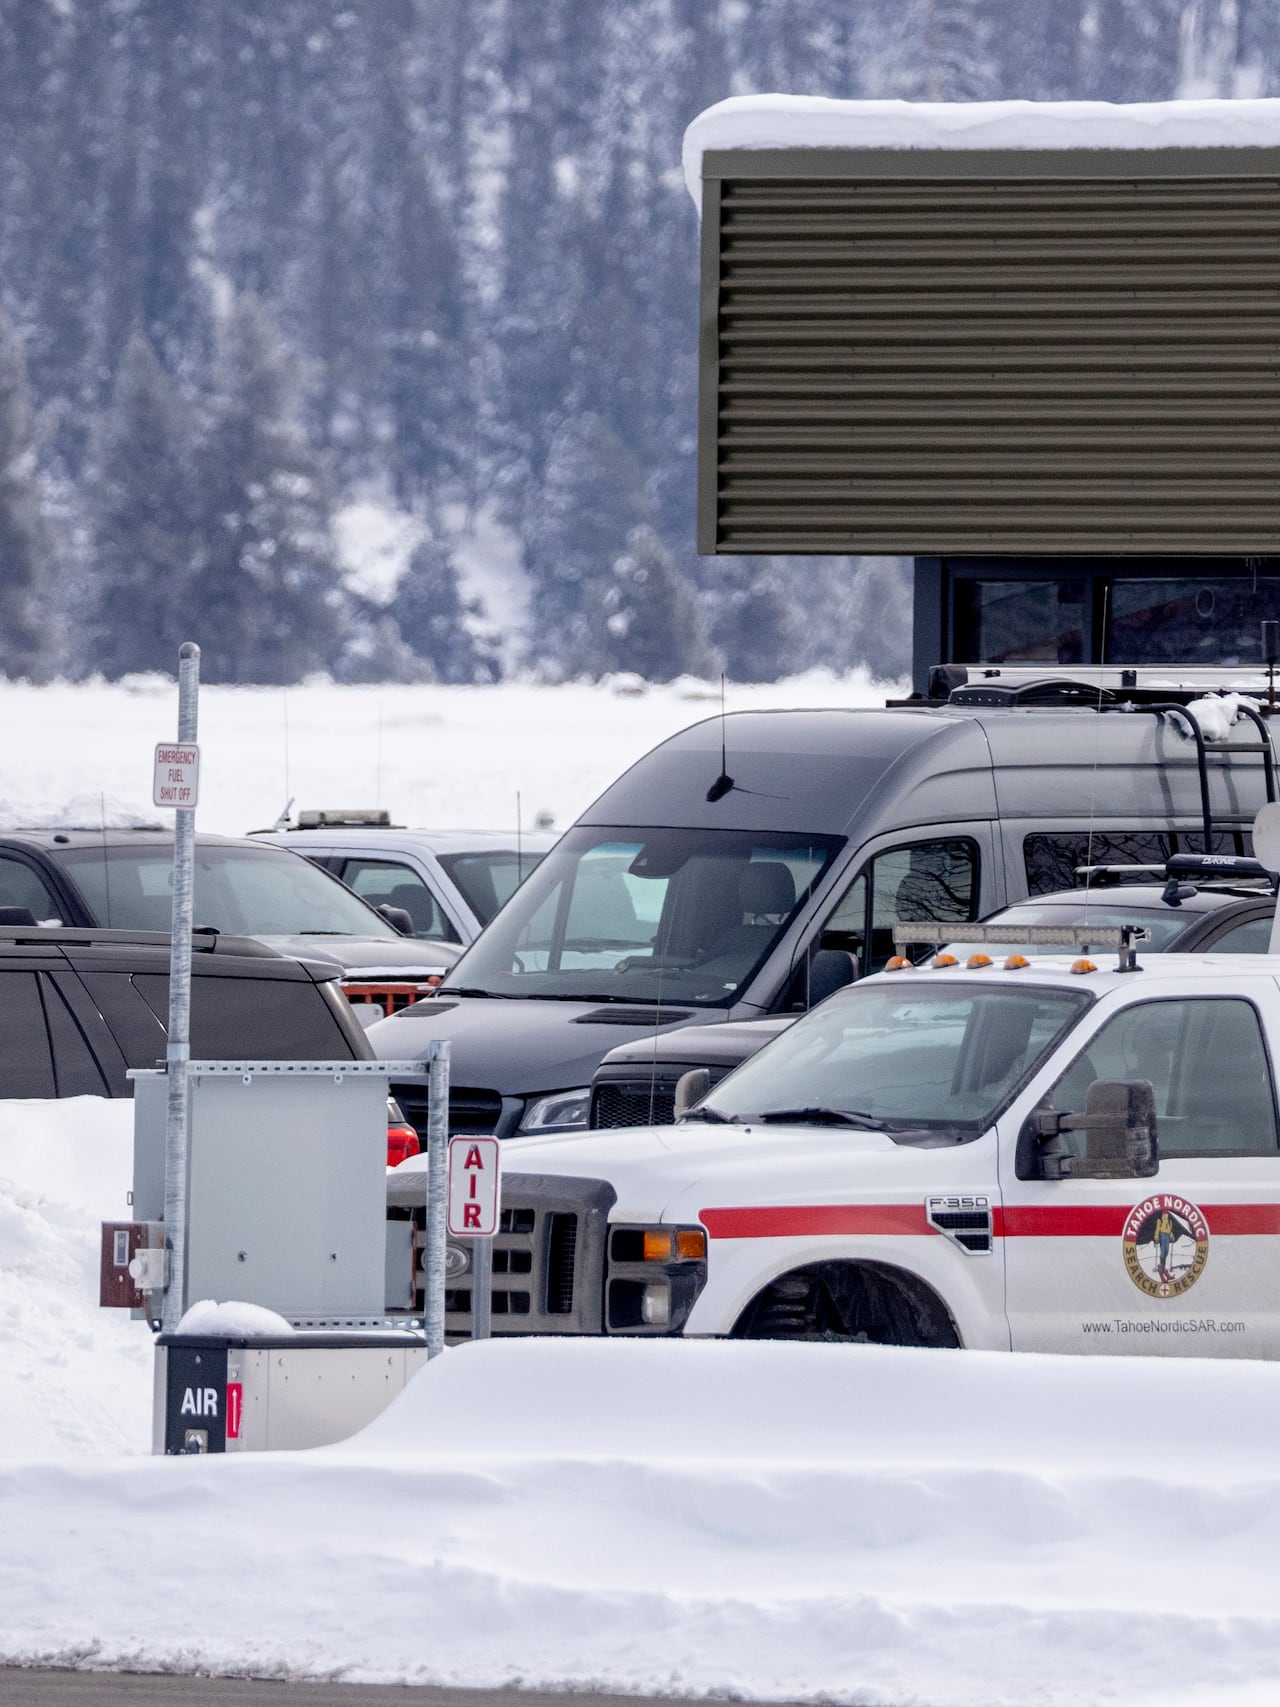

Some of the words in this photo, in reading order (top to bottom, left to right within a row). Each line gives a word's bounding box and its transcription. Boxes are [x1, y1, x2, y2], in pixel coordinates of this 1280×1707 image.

[158, 750, 196, 765] EMERGENCY
[168, 768, 184, 782] FUEL
[160, 786, 177, 800] SHUT
[178, 787, 191, 800] OFF
[463, 1144, 484, 1228] AIR
[1126, 1197, 1160, 1237] TAHOE
[1164, 1196, 1206, 1237] NORDIC
[1125, 1246, 1158, 1294] SEARCH
[1173, 1246, 1207, 1293] RESCUE
[1081, 1319, 1245, 1333] www.TahoeNordicSAR.com
[181, 1387, 218, 1416] AIR
